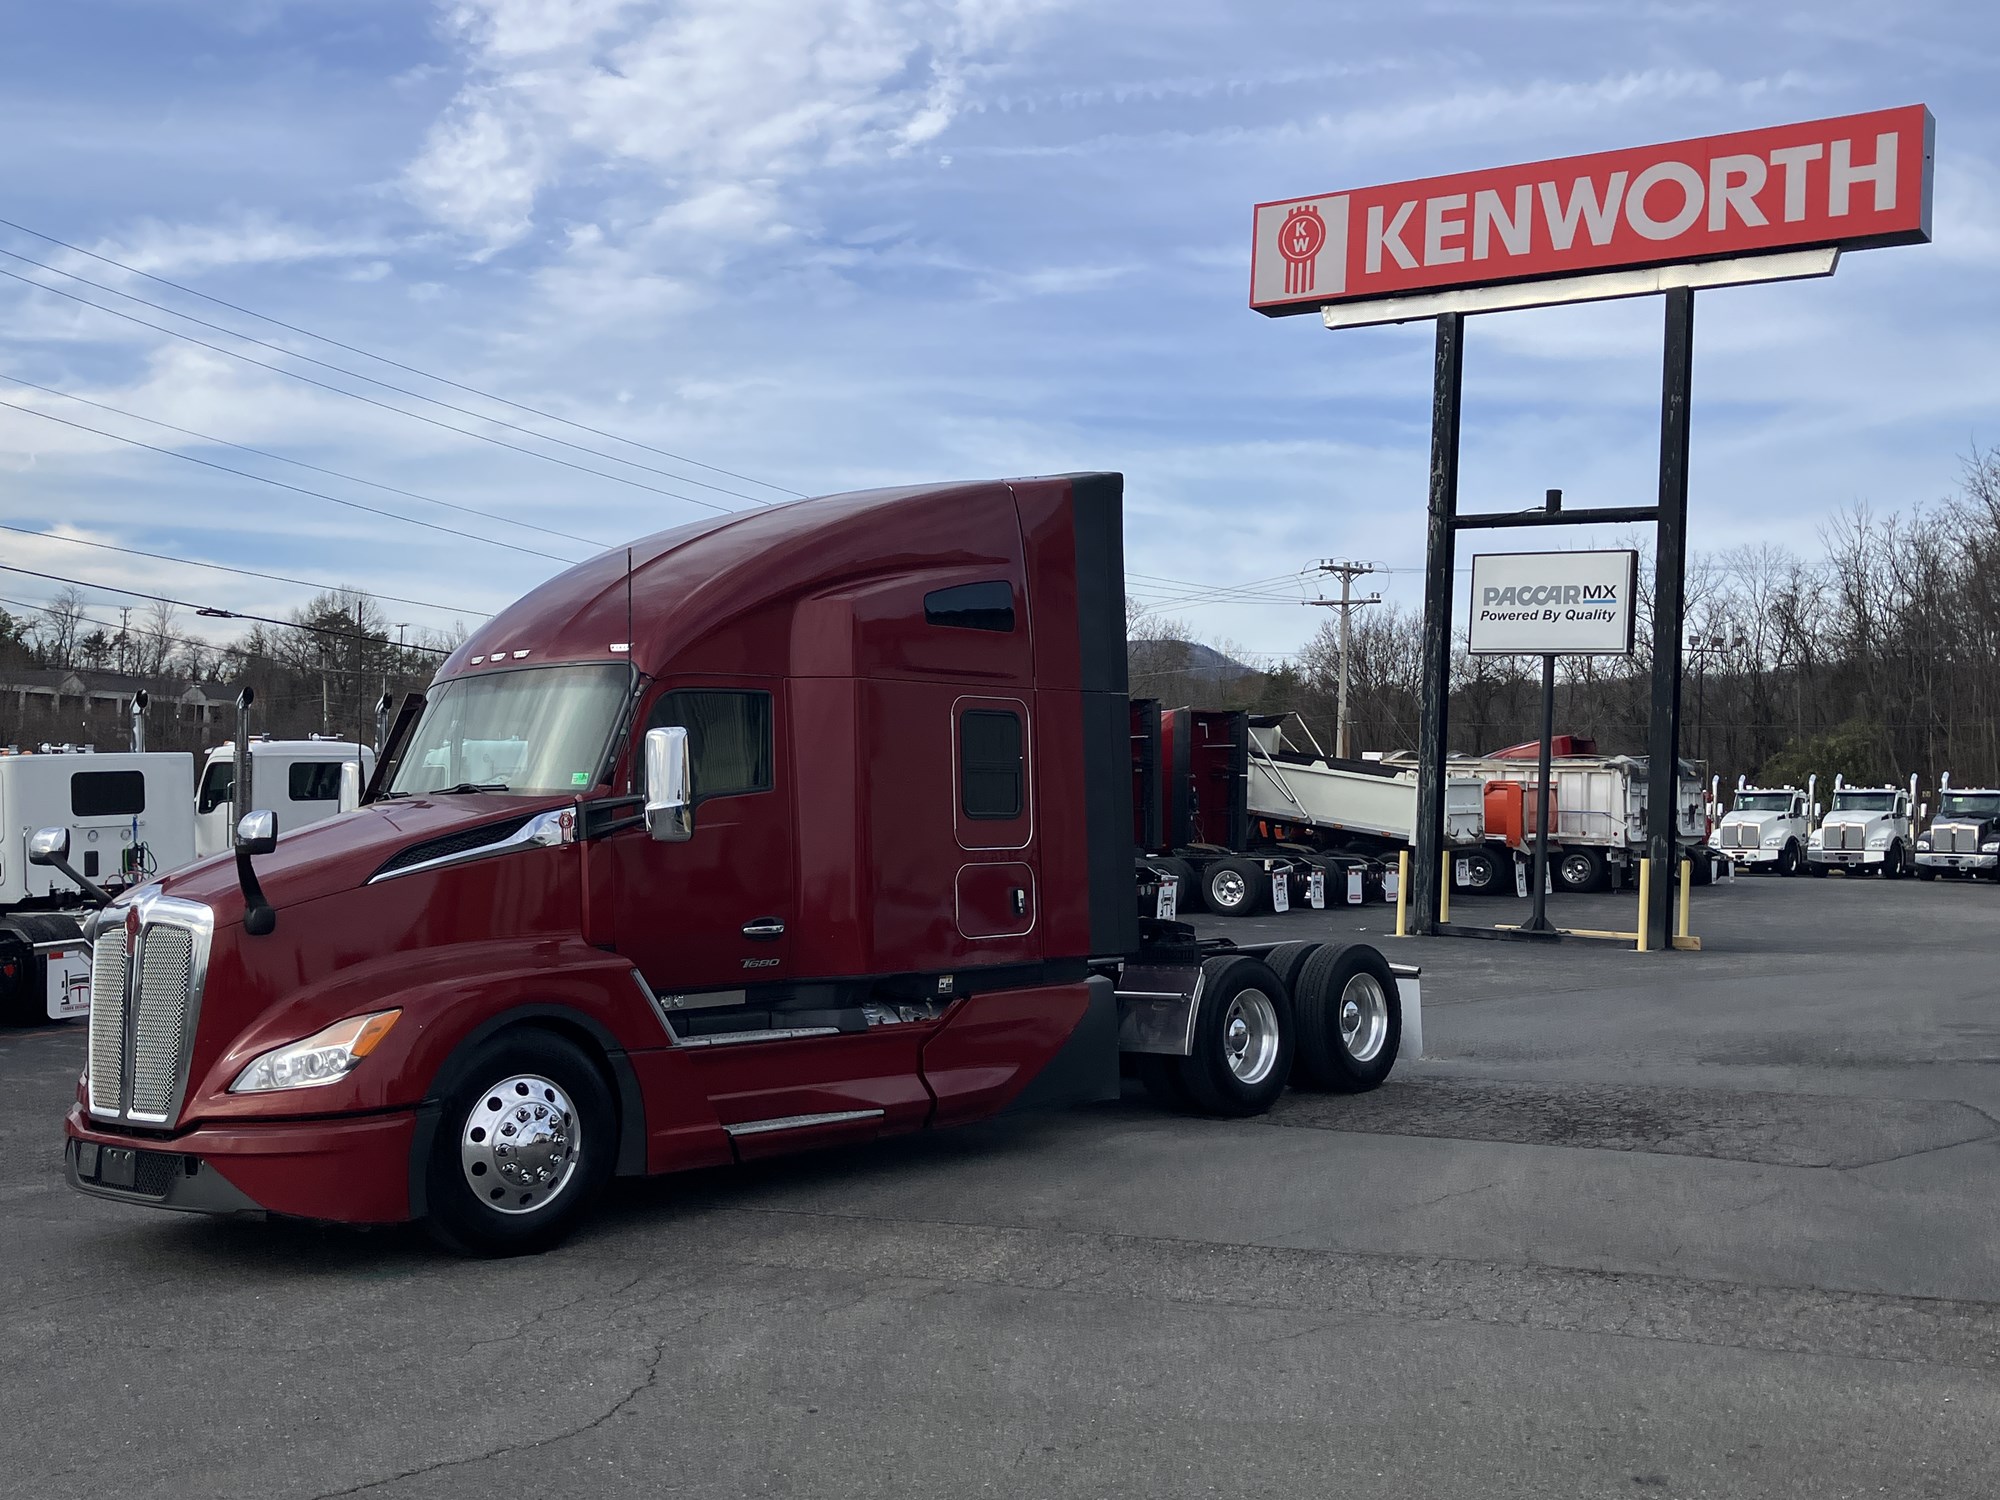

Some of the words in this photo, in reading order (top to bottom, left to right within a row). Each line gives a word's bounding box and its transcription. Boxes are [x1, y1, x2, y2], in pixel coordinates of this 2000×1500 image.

[1364, 131, 1898, 274] KENWORTH
[1480, 610, 1539, 621] Powered
[1542, 610, 1561, 623] By
[1565, 609, 1616, 622] Quality
[741, 958, 780, 969] T680
